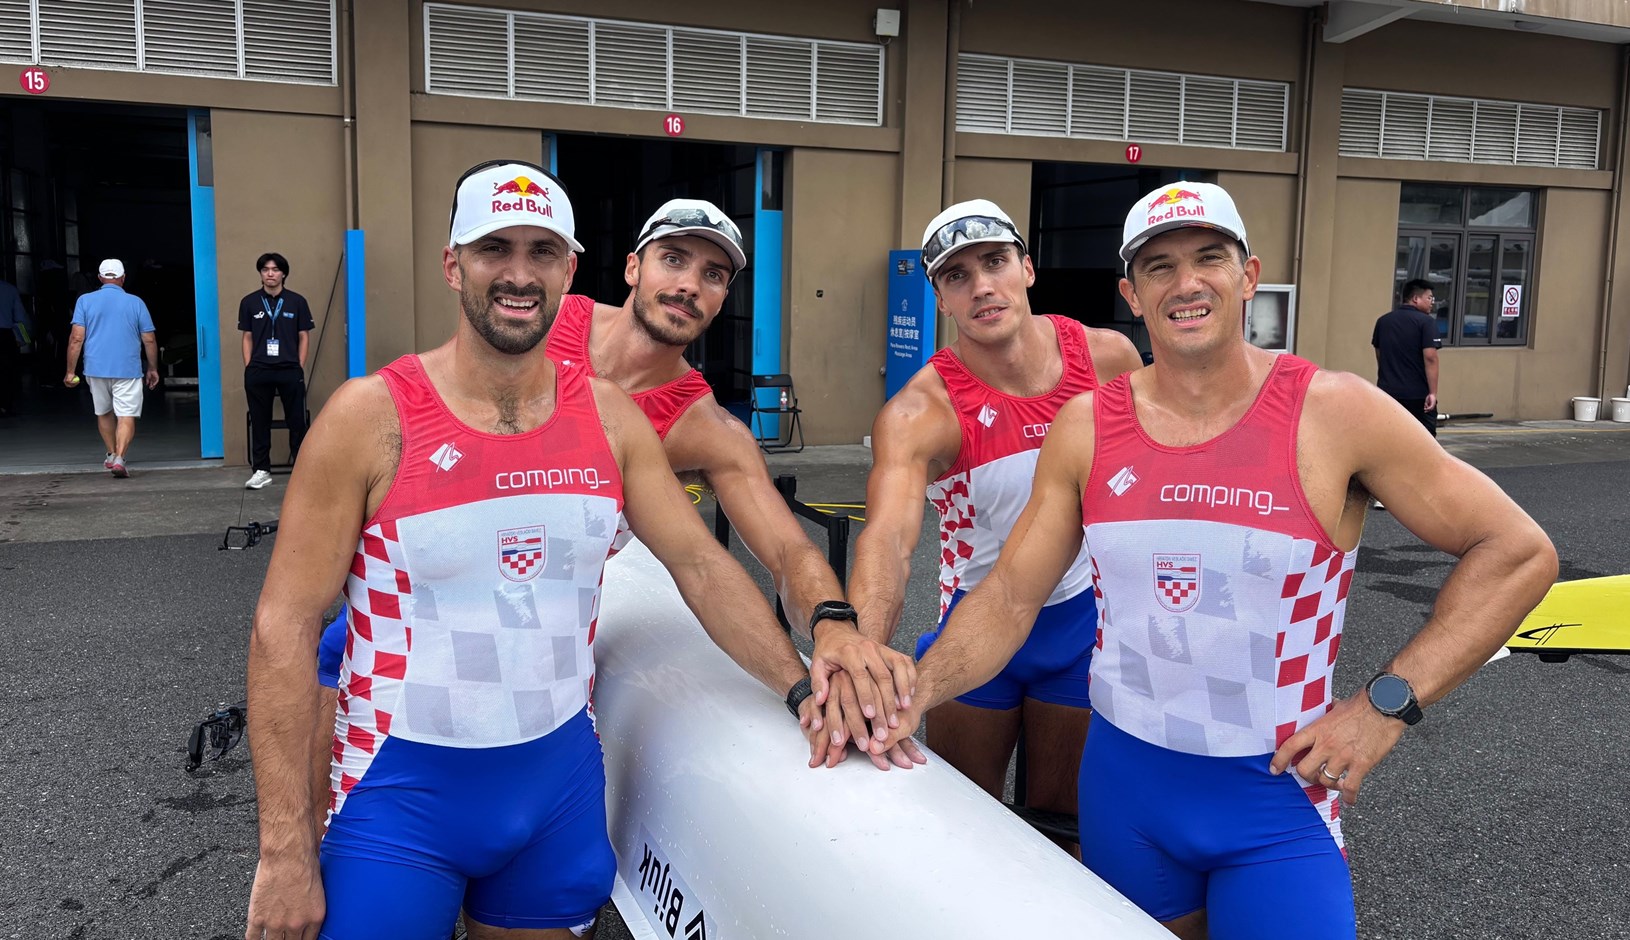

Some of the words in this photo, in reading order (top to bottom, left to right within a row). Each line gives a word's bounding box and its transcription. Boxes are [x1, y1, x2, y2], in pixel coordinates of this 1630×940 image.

[25, 71, 45, 90] 15
[667, 117, 681, 133] 16
[1129, 146, 1139, 160] 17
[492, 197, 523, 213] Red
[526, 198, 553, 219] Bull
[1148, 206, 1174, 225] Red
[1176, 205, 1205, 217] Bull
[501, 535, 518, 544] HVS
[638, 842, 684, 939] Bijuk
